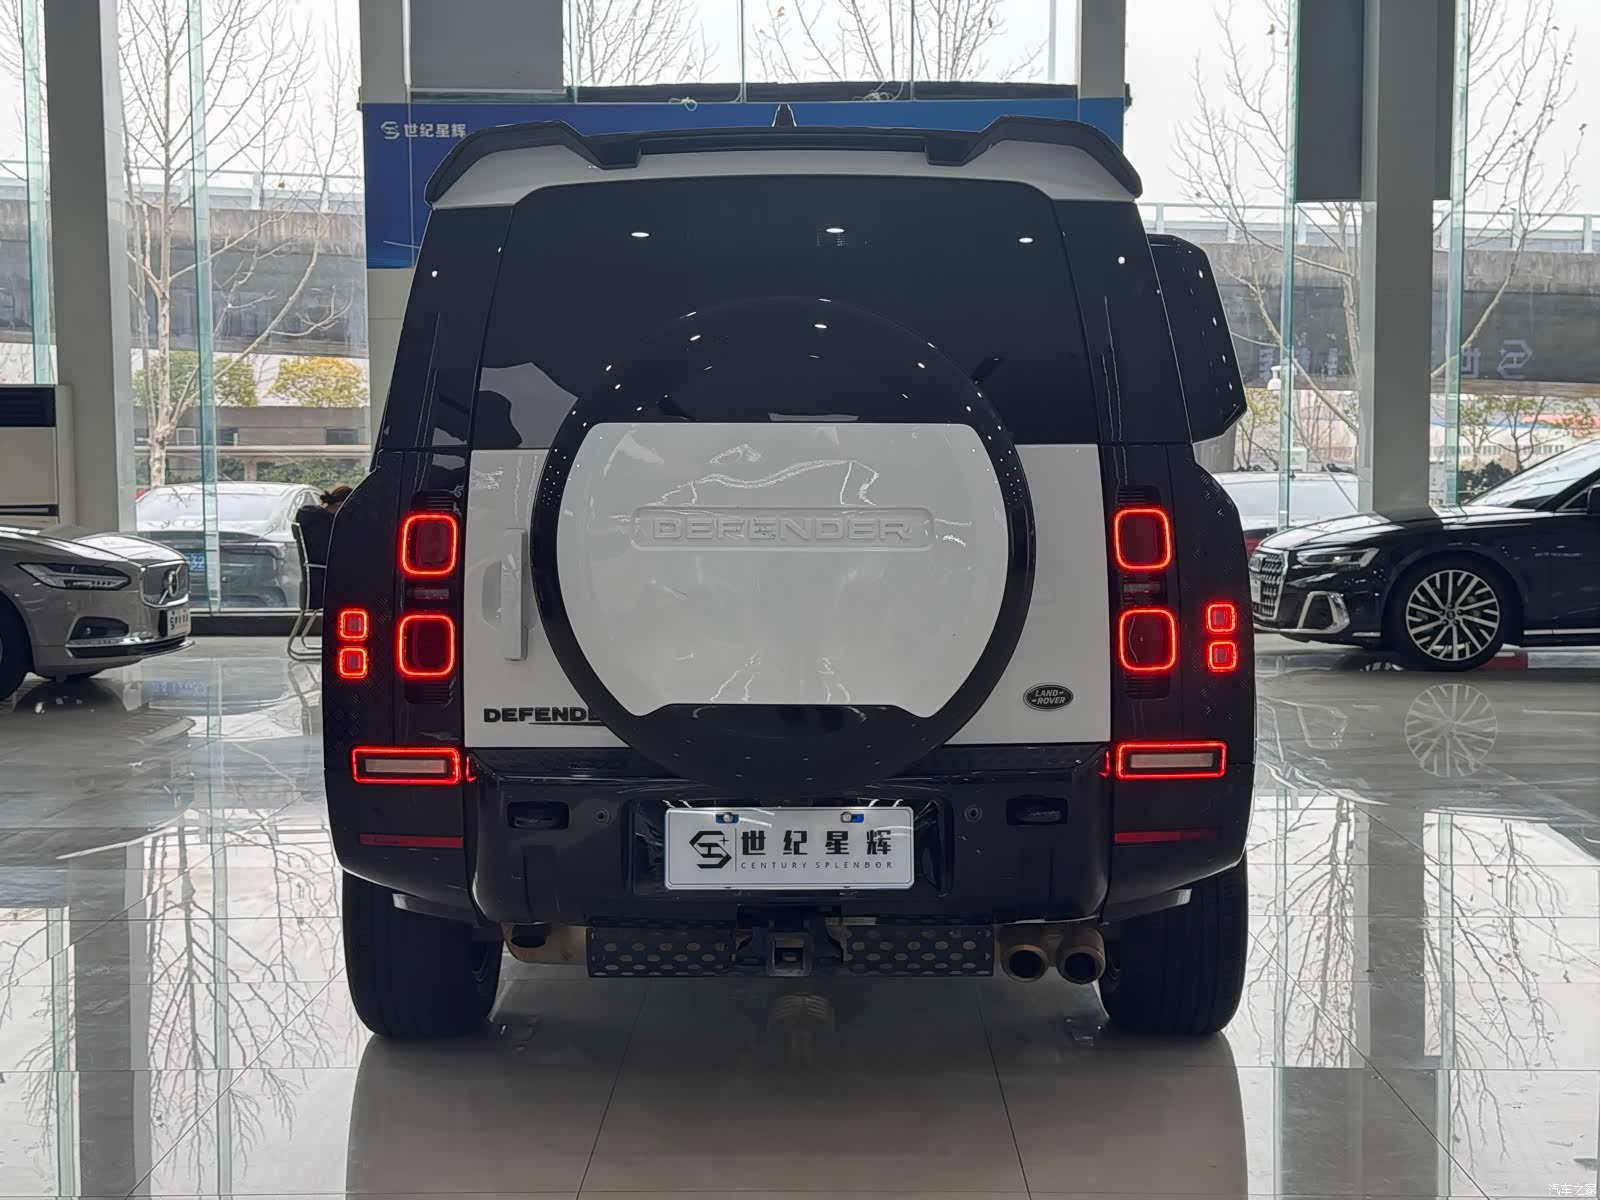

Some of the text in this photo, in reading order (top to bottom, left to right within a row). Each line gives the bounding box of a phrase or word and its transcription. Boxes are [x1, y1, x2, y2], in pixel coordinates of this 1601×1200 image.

[403, 123, 466, 138] 世纪星辉
[652, 517, 914, 540] DEFENDER
[741, 830, 892, 856] 世纪星辉
[740, 861, 807, 869] CENTURY
